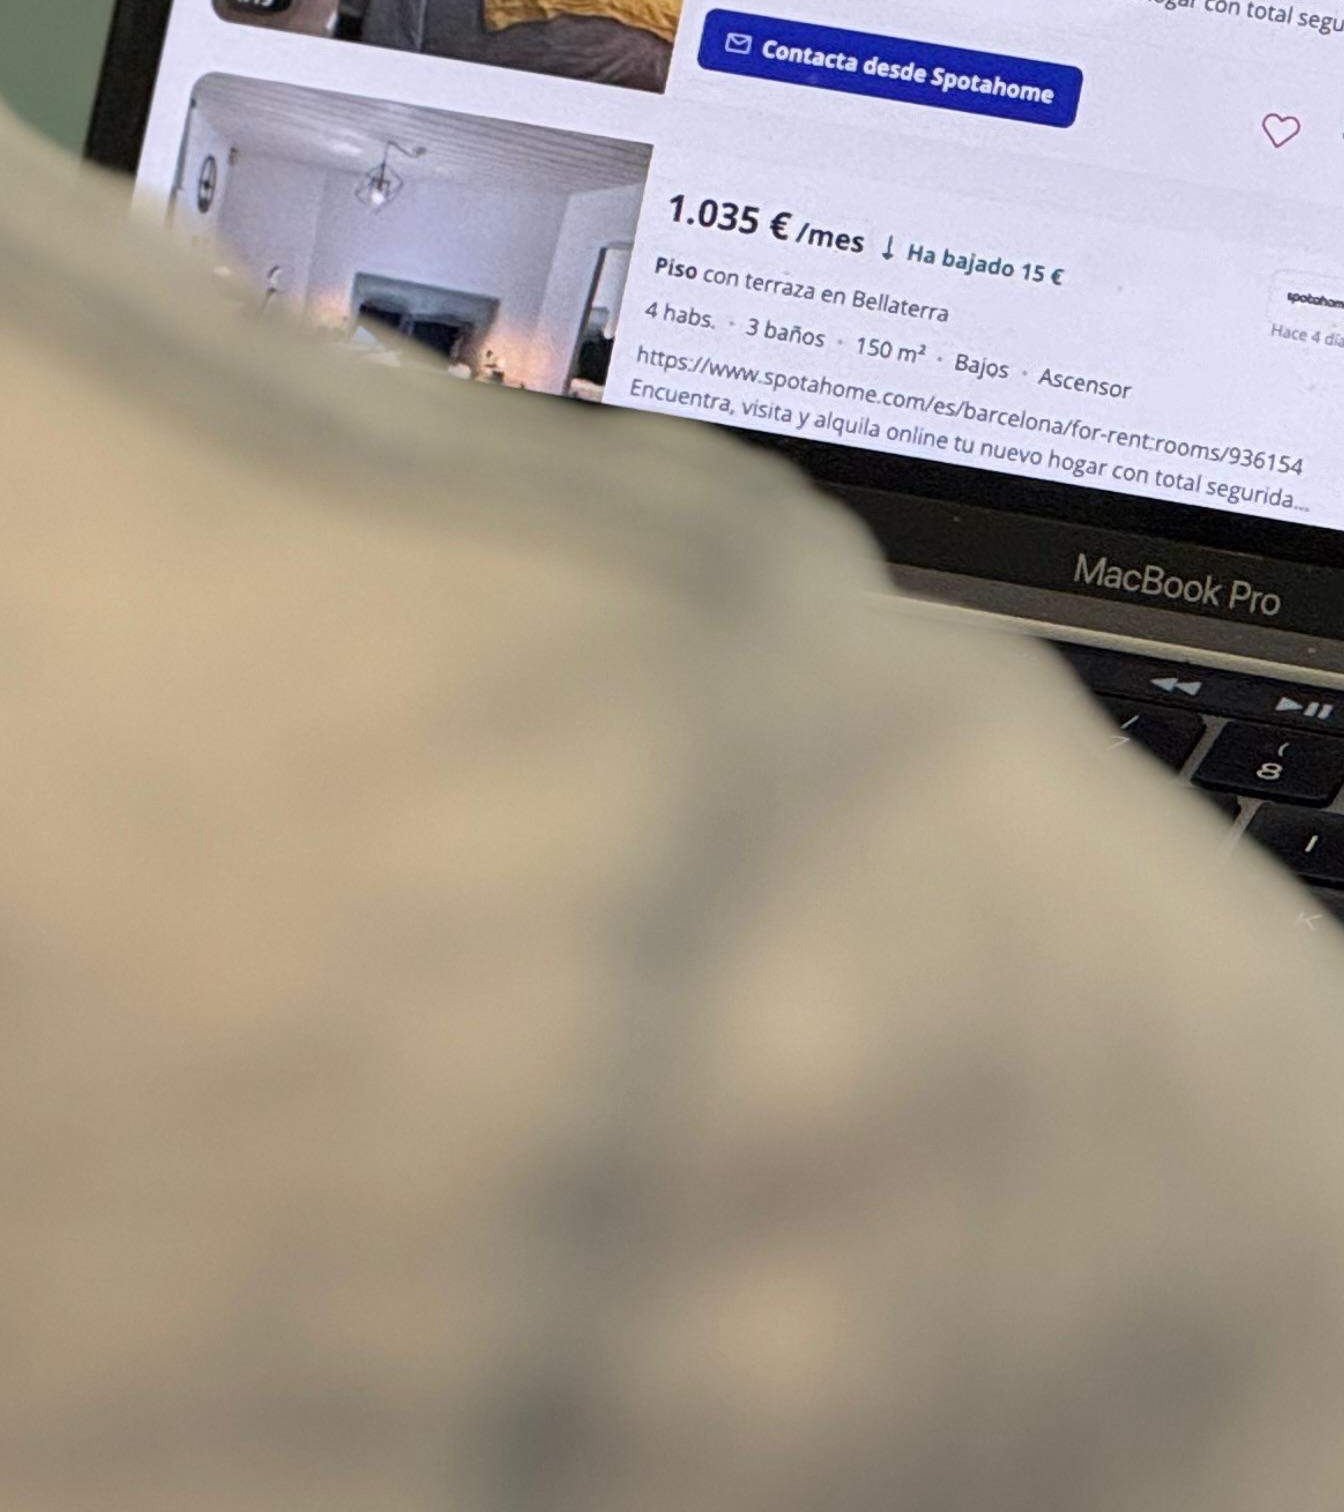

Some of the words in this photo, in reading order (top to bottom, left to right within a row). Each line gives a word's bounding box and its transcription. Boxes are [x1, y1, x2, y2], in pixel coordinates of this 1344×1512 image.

[1245, 0, 1294, 25] total
[761, 38, 859, 72] Contacta
[861, 55, 928, 84] desde
[929, 66, 1055, 104] Spotahome
[668, 193, 760, 235] 1.035
[768, 210, 792, 241] €
[794, 221, 865, 253] /mes
[906, 242, 936, 265] Ha
[940, 247, 1015, 278] bajado
[1021, 262, 1045, 283] 15
[1049, 267, 1065, 286] €
[1073, 552, 1222, 607] MacBook
[1228, 579, 1281, 616] Pro
[1256, 762, 1283, 780] 8
